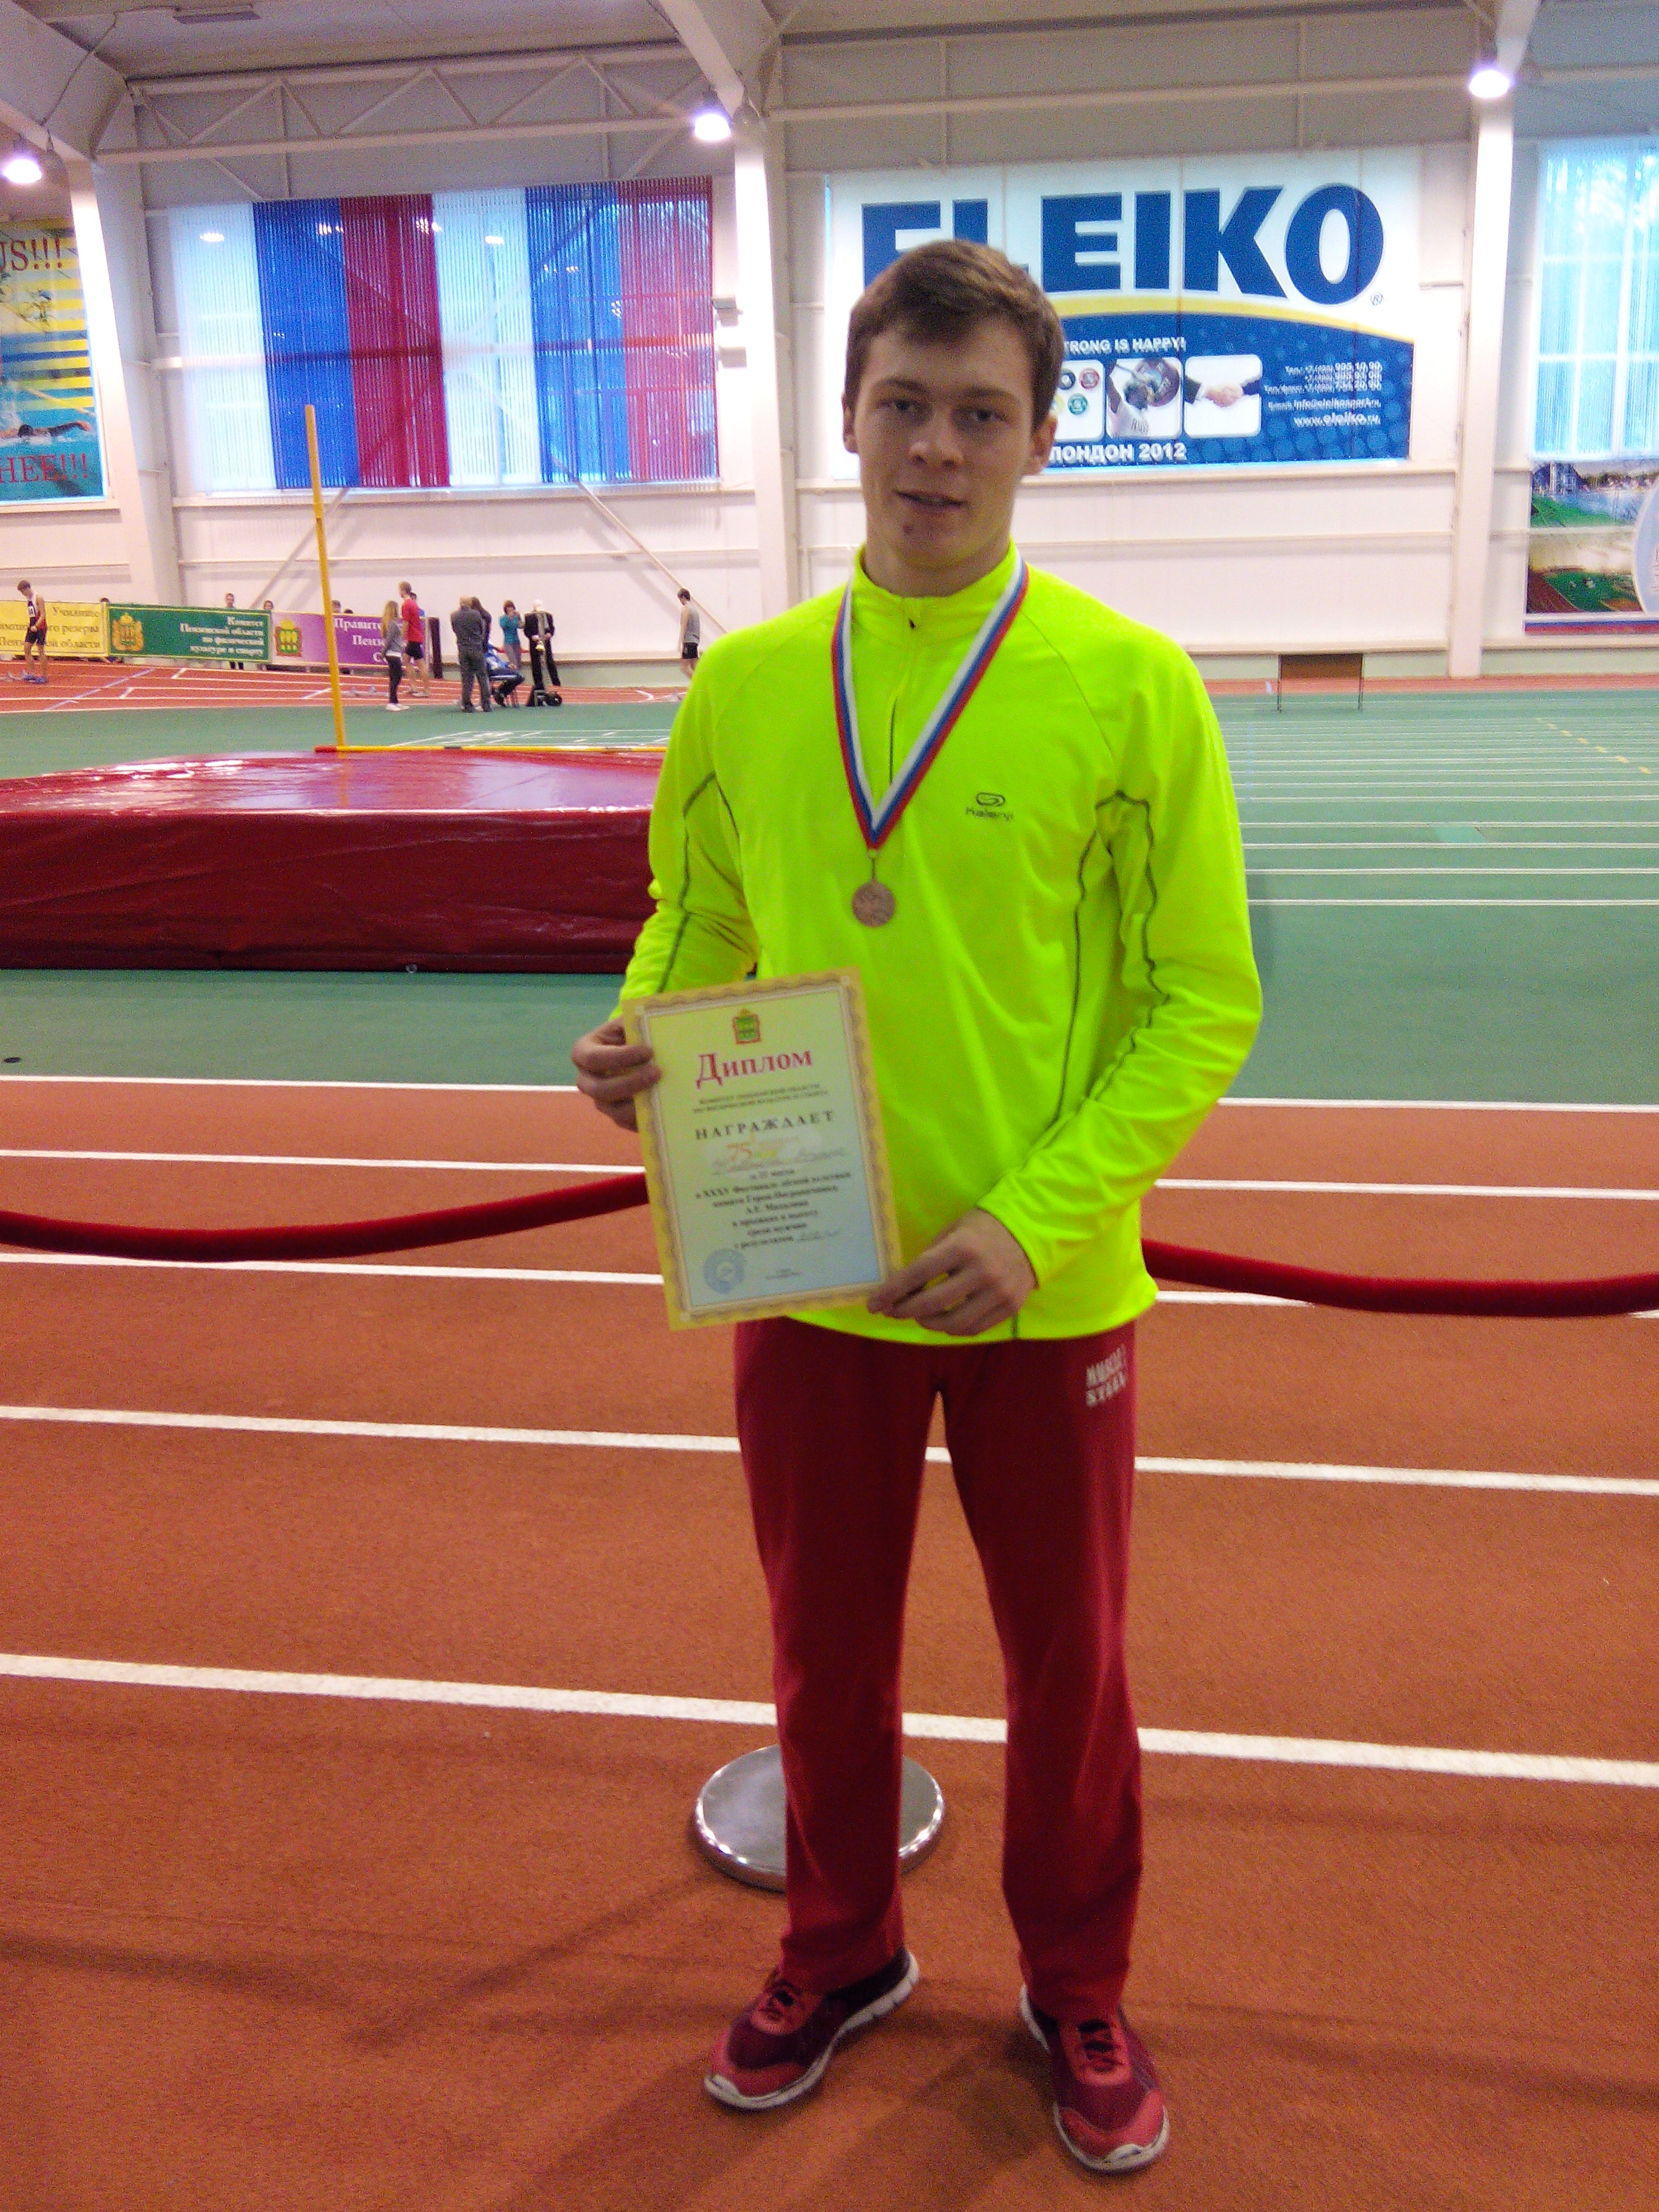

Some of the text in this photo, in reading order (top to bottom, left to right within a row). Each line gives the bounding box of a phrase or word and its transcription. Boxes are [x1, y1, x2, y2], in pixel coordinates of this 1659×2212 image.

[1064, 336, 1186, 354] TRONG IS HAPPY!
[1294, 411, 1381, 427] www.eleiko.ru
[1138, 443, 1187, 461] 2012
[696, 1050, 812, 1089] Диплом
[695, 1110, 833, 1140] НАГРАЖДАЕТ
